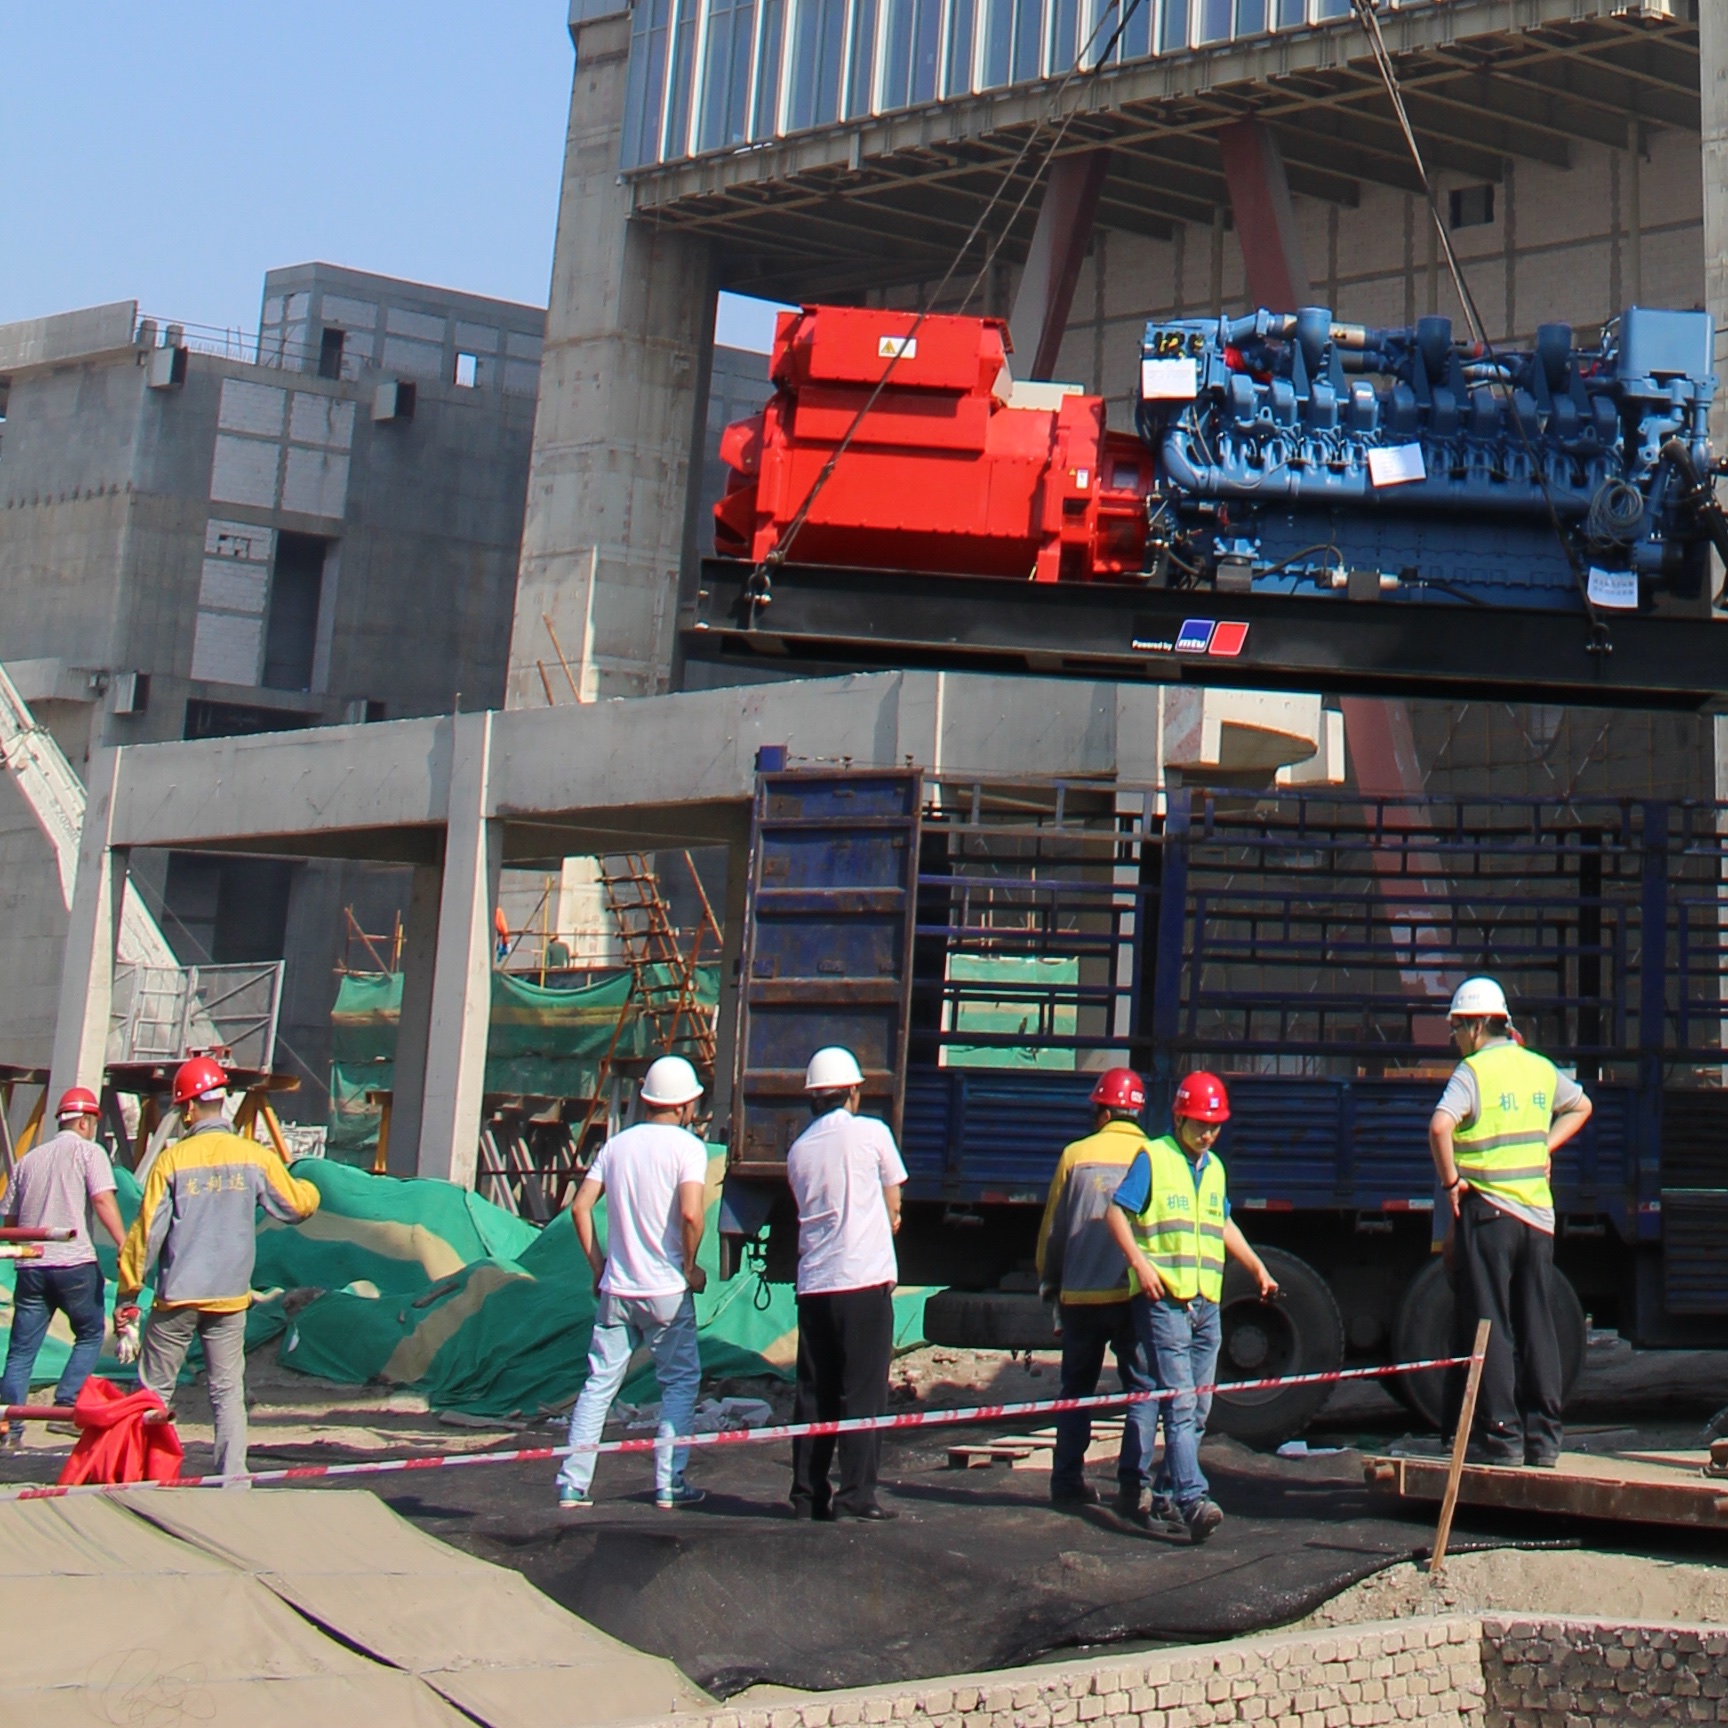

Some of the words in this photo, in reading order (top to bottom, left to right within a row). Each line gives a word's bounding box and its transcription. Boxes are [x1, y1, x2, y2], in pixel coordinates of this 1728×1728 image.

[1132, 639, 1163, 650] Powered
[1178, 638, 1206, 649] mtu
[1499, 1090, 1546, 1112] 机电
